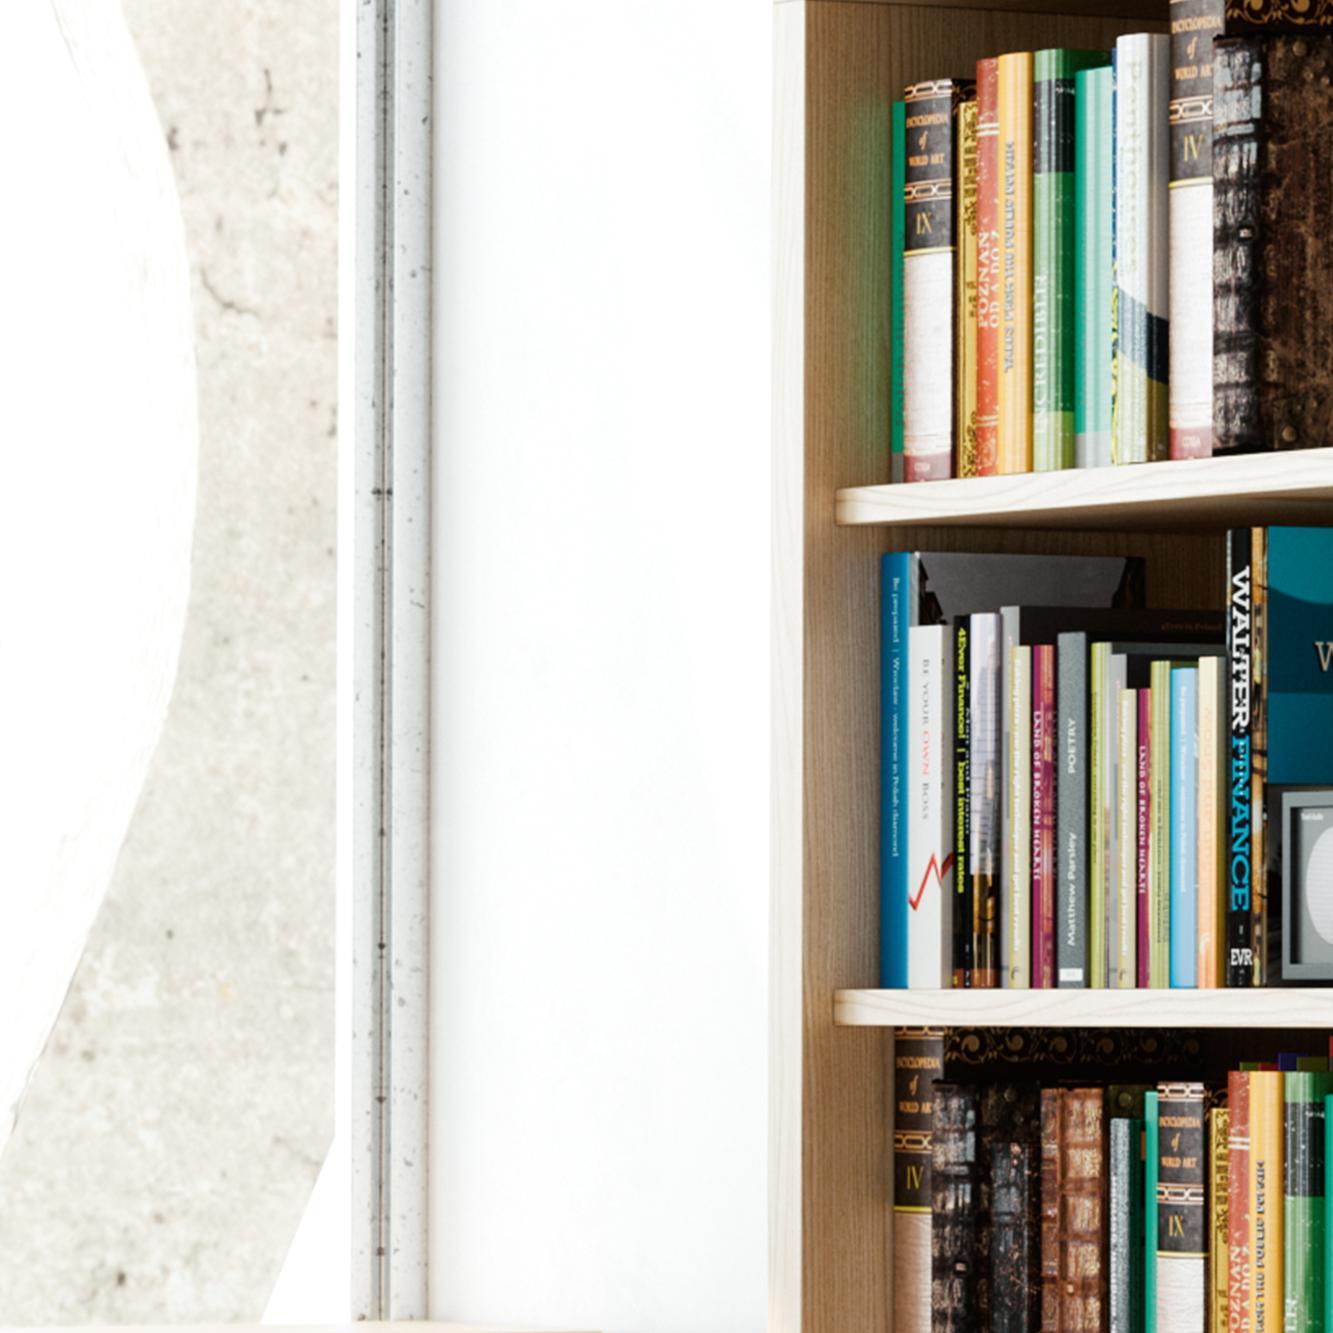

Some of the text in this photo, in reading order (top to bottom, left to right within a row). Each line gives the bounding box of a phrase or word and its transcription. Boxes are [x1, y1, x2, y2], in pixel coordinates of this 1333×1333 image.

[1184, 136, 1202, 162] IV
[915, 213, 932, 235] IX
[1067, 718, 1078, 774] POETRY
[1231, 566, 1251, 912] WALTER FINANCE
[1067, 832, 1078, 947] Matthew Parsley
[1230, 948, 1253, 966] EVR
[906, 1165, 924, 1190] IV
[1168, 1215, 1185, 1237] IX
